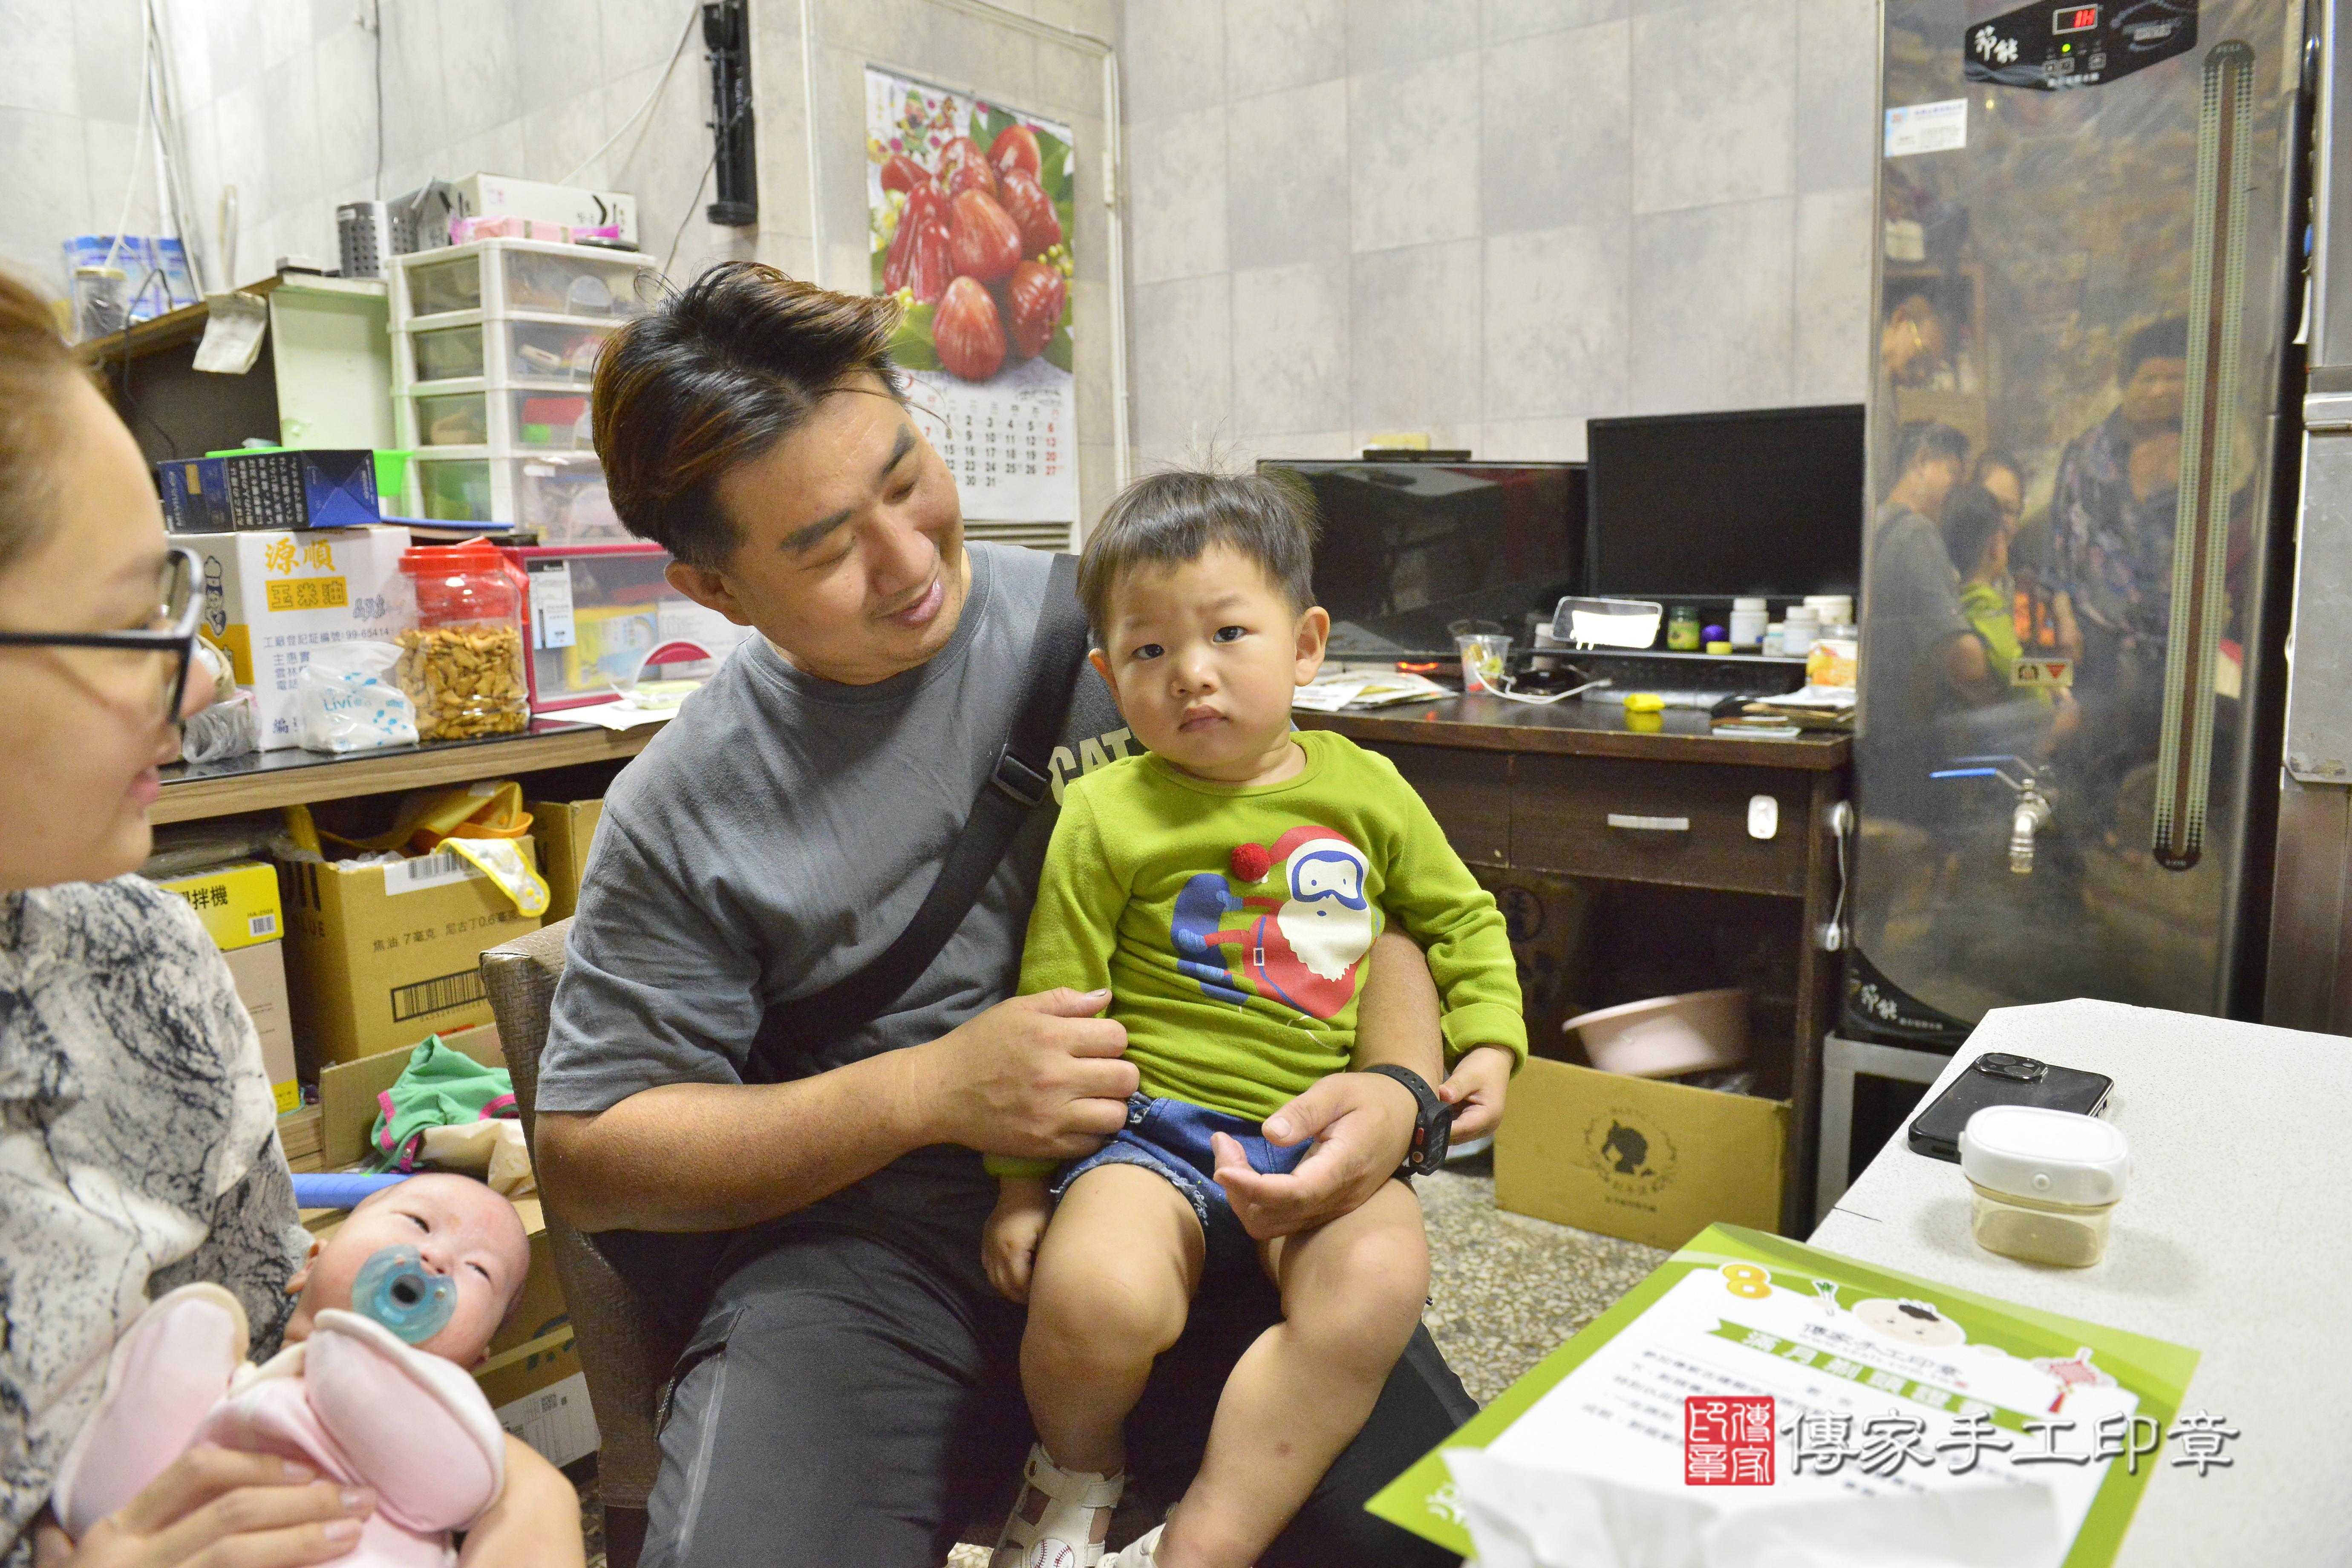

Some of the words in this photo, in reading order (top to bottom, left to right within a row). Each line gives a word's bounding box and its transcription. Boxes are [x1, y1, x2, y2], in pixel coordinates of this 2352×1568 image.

[966, 415, 972, 426] 2
[988, 417, 993, 427] 3
[1008, 419, 1013, 429] 4
[1028, 420, 1034, 431] 5
[1048, 422, 1054, 433] 6
[966, 430, 972, 441] 9
[986, 432, 996, 443] 10
[1006, 435, 1015, 445] 11
[1026, 435, 1036, 446] 12
[1046, 437, 1056, 447] 13
[945, 444, 954, 455] 15
[965, 446, 976, 456] 16
[986, 447, 996, 458] 17
[1006, 449, 1016, 459] 18
[1026, 450, 1036, 461] 19
[1046, 452, 1057, 462] 20
[965, 460, 975, 471] 23
[986, 461, 996, 472] 24
[1006, 462, 1016, 474] 25
[1026, 464, 1036, 475] 26
[1046, 465, 1057, 476] 27
[966, 475, 976, 487] 30
[986, 476, 996, 487] 31
[265, 536, 336, 576] 源順
[1047, 727, 1132, 807] CAT
